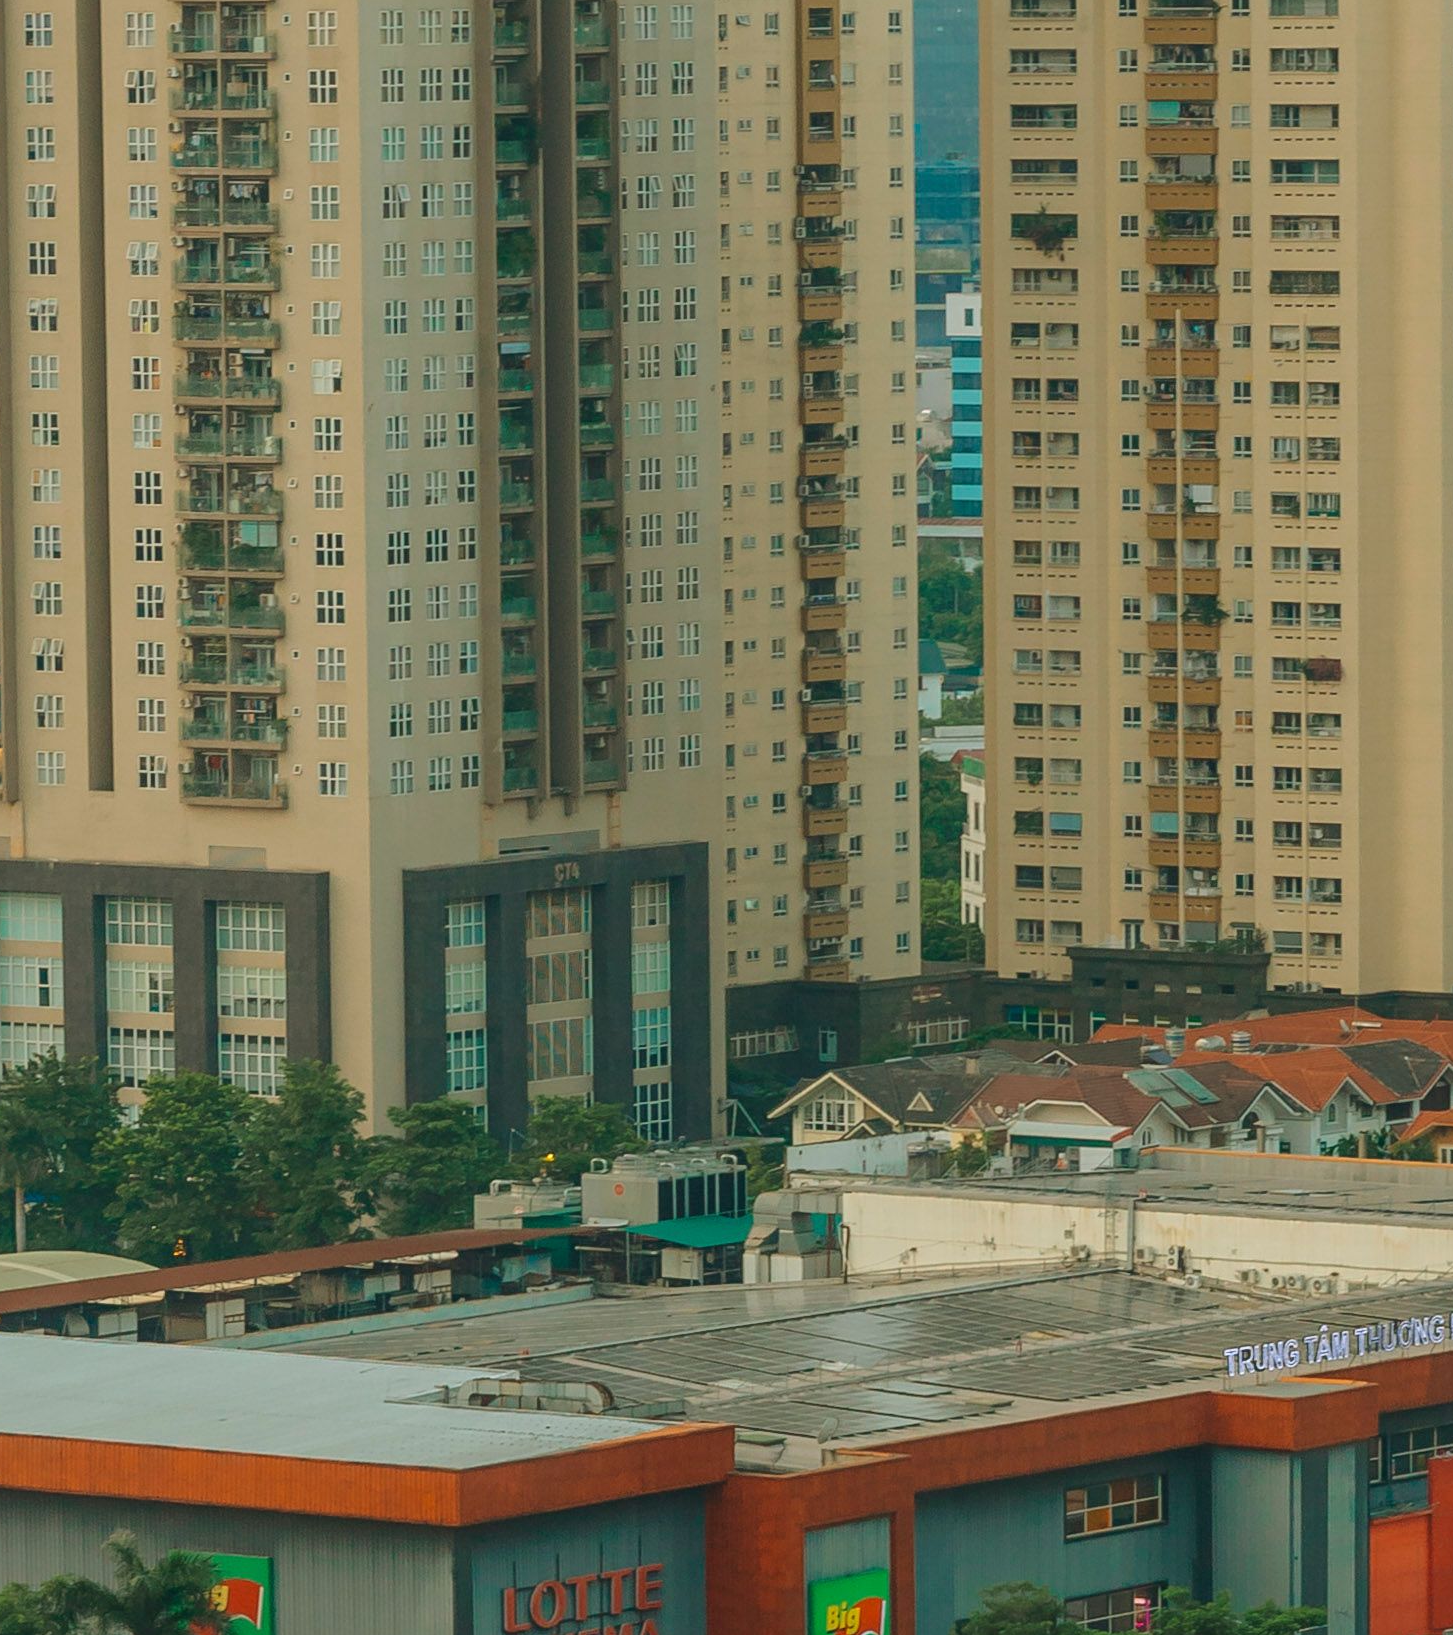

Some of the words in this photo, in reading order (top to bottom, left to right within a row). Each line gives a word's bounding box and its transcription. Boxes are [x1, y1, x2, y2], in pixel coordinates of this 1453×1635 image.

[1224, 1339, 1300, 1377] TRUNG
[1304, 1325, 1349, 1364] TÂM
[1355, 1315, 1445, 1356] THƯƠNG
[503, 1563, 664, 1634] LOTTE
[826, 1601, 861, 1635] Big
